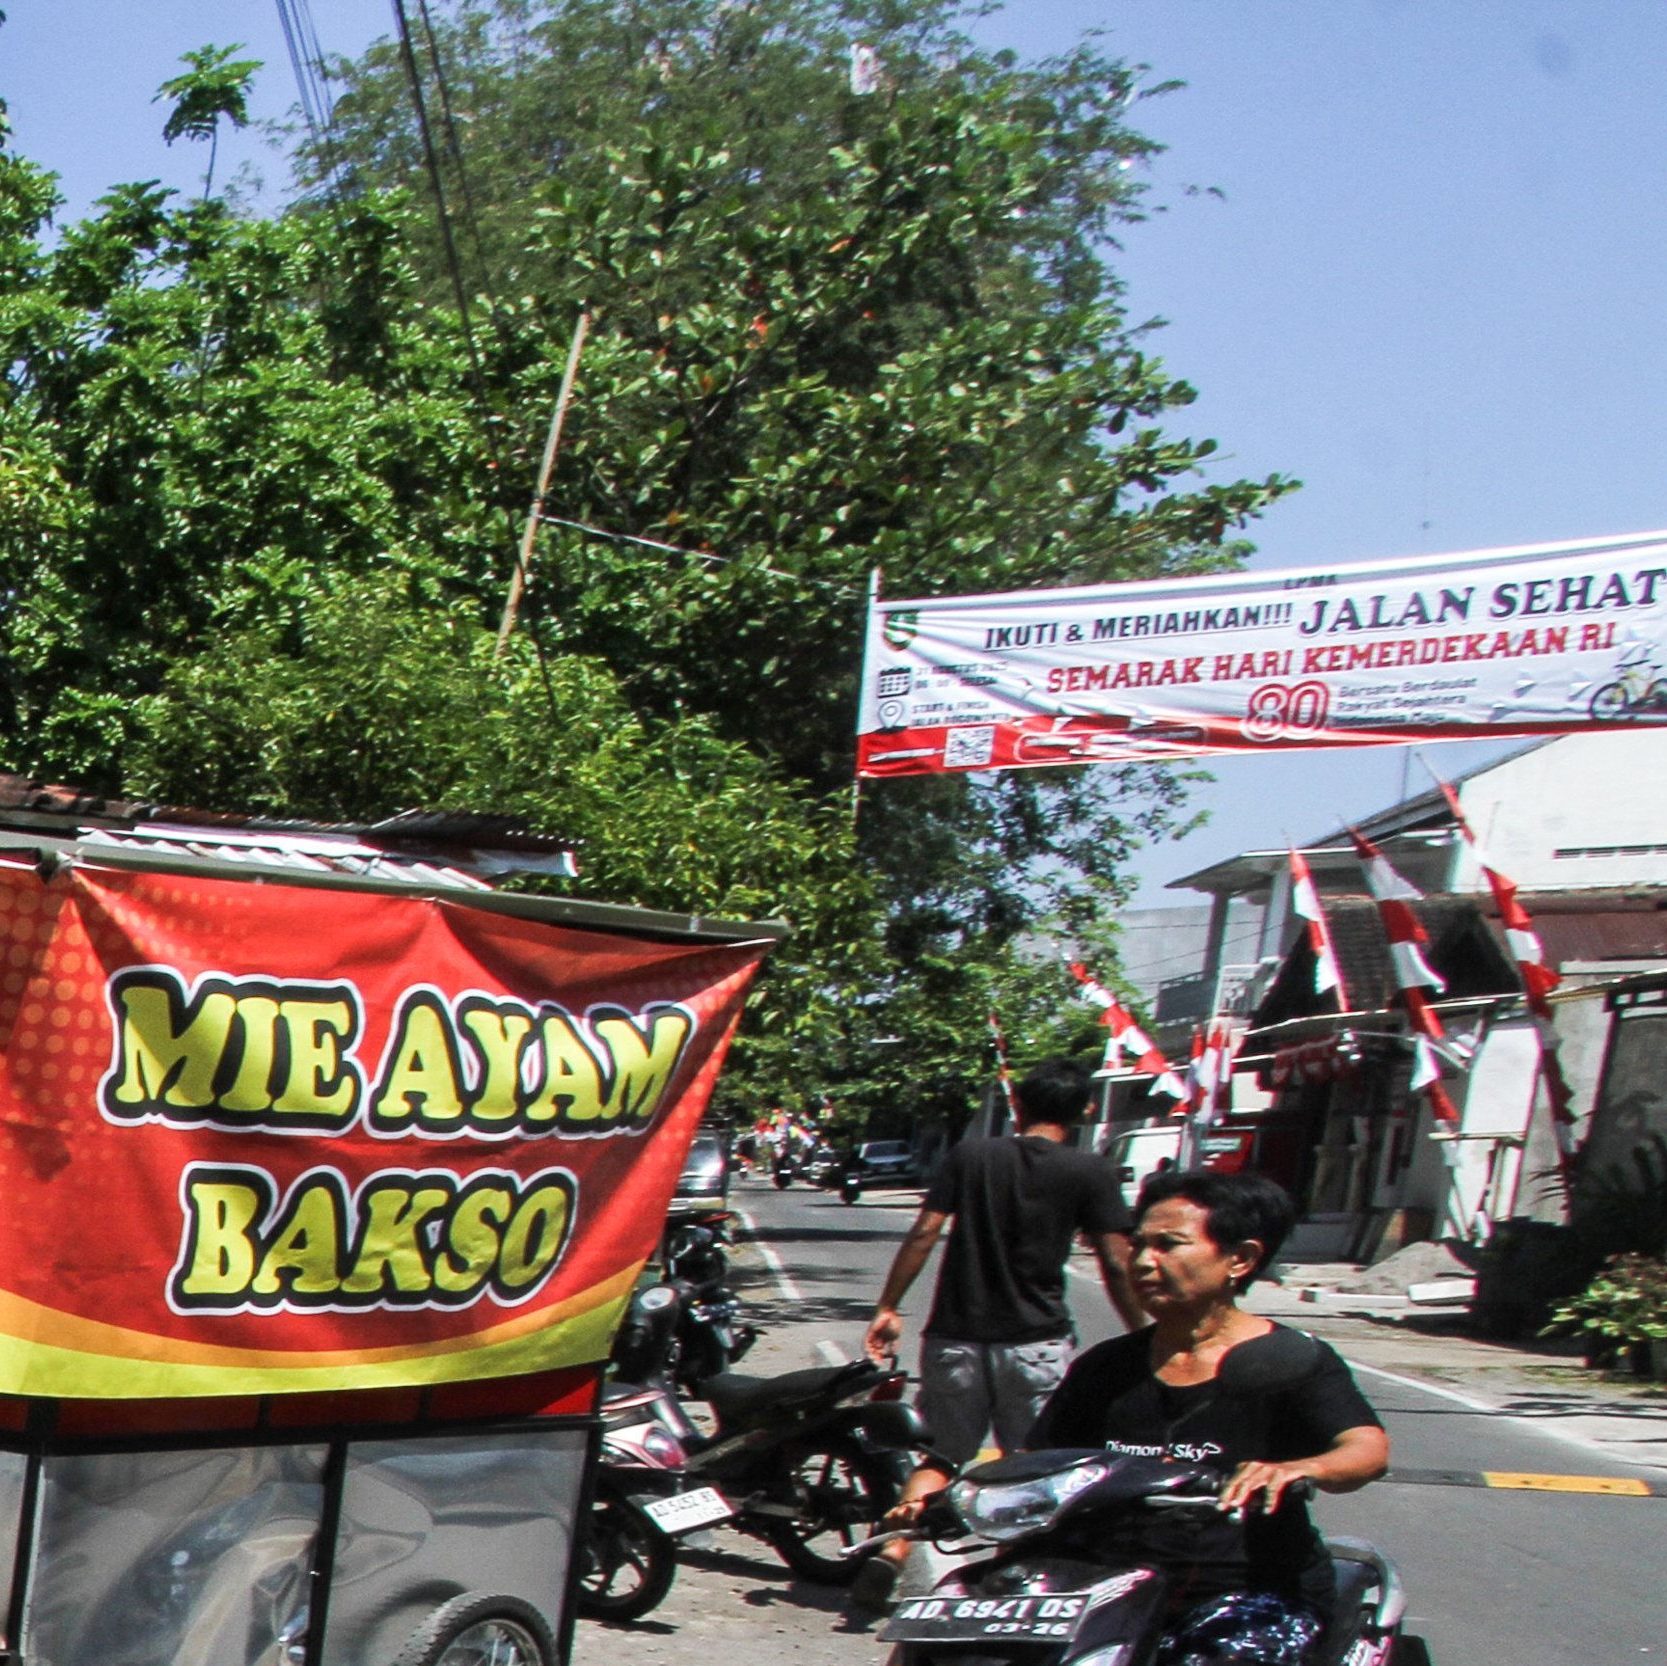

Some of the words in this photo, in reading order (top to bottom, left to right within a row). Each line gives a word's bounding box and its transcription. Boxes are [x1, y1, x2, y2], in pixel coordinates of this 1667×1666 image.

[985, 622, 1057, 649] IKUTI
[1067, 625, 1083, 642] &
[1093, 603, 1293, 641] MERIAHKAN!!!
[1300, 587, 1475, 635] JALAN
[1490, 568, 1667, 619] SEHAT
[1047, 657, 1204, 693] SEMARAK
[1212, 650, 1294, 681] HARI
[1301, 625, 1569, 675] KEMERDEKAAN
[1579, 621, 1617, 652] RI
[1241, 680, 1330, 742] 80
[103, 972, 359, 1128] MIE
[369, 988, 692, 1133] AYAM
[172, 1167, 572, 1308] BAKSO
[1173, 1443, 1208, 1462] Sky
[901, 1600, 947, 1620] AD
[1037, 1599, 1083, 1619] DS
